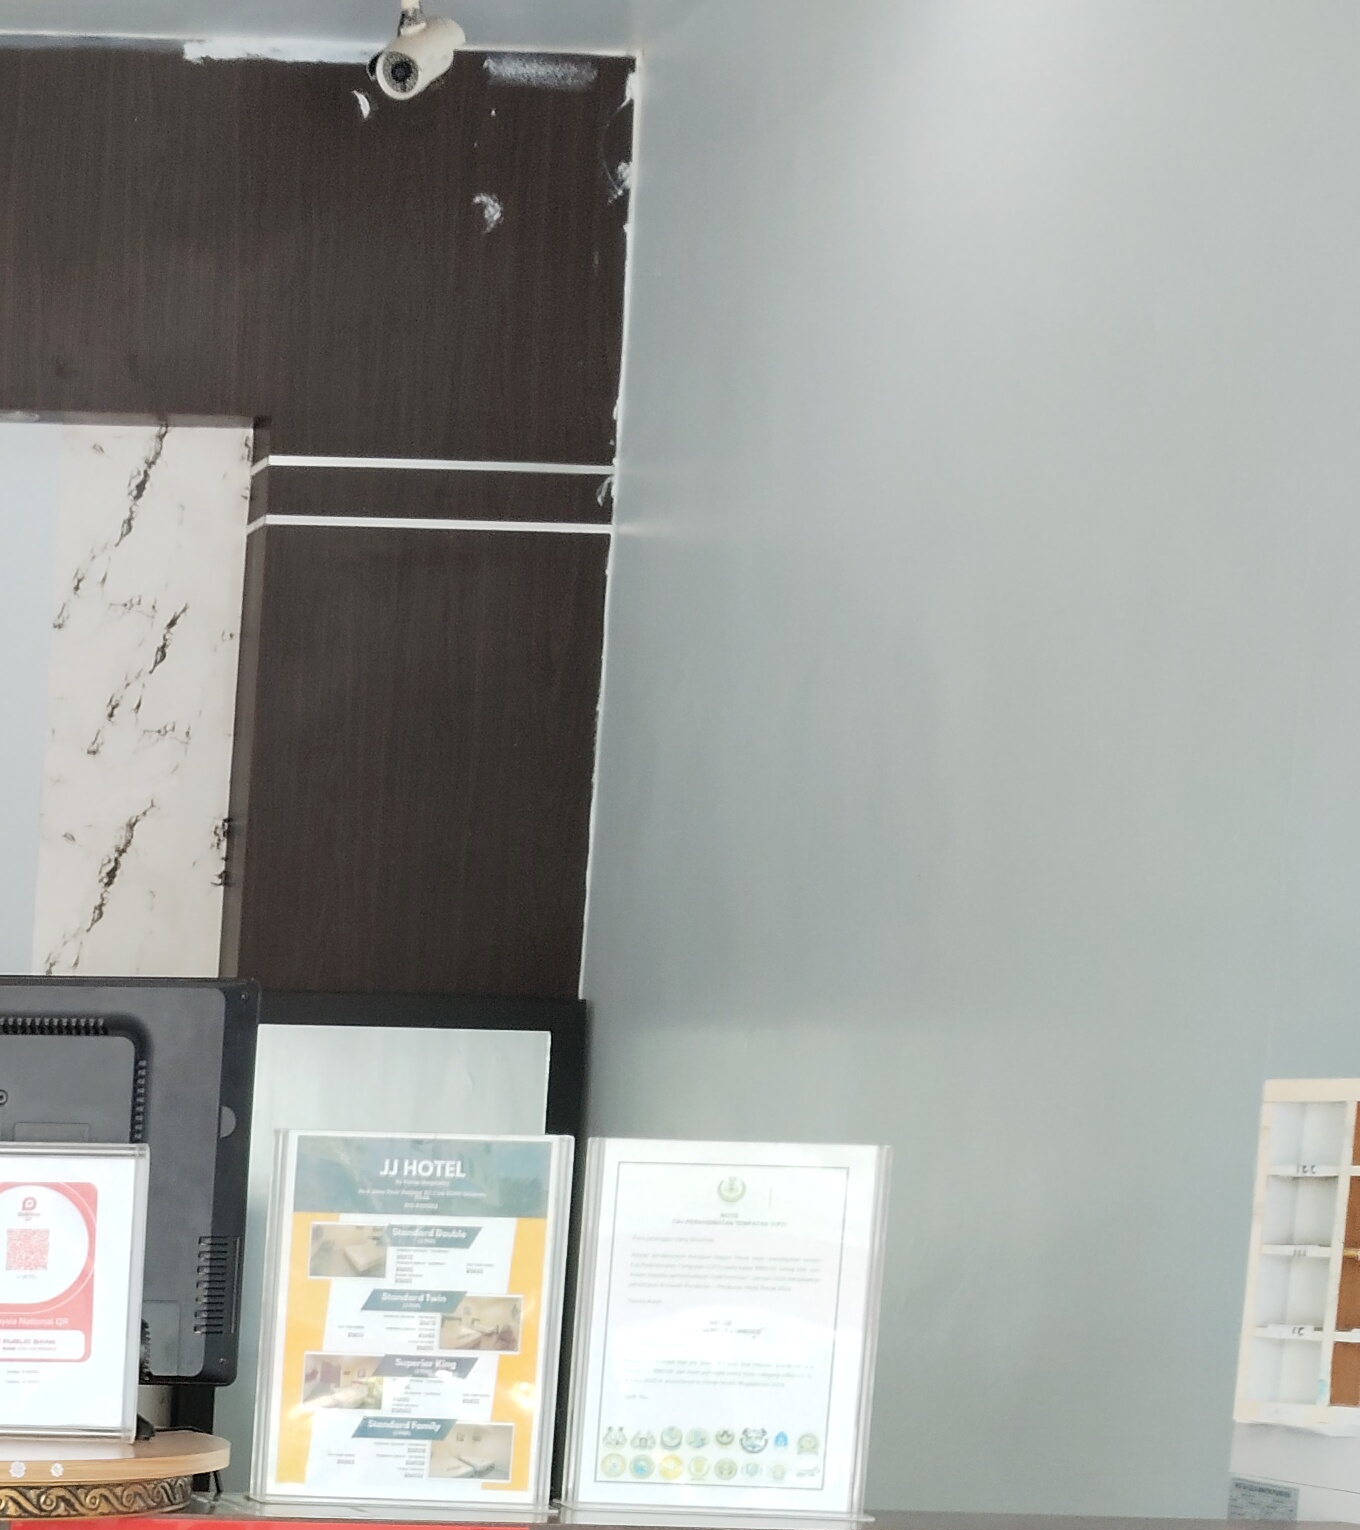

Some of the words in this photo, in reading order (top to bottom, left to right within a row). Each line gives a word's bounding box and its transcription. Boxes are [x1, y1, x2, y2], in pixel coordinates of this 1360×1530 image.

[379, 1158, 399, 1176] JJ
[403, 1159, 466, 1178] HOTEL
[392, 1227, 434, 1237] Standard
[381, 1291, 424, 1302] Standard
